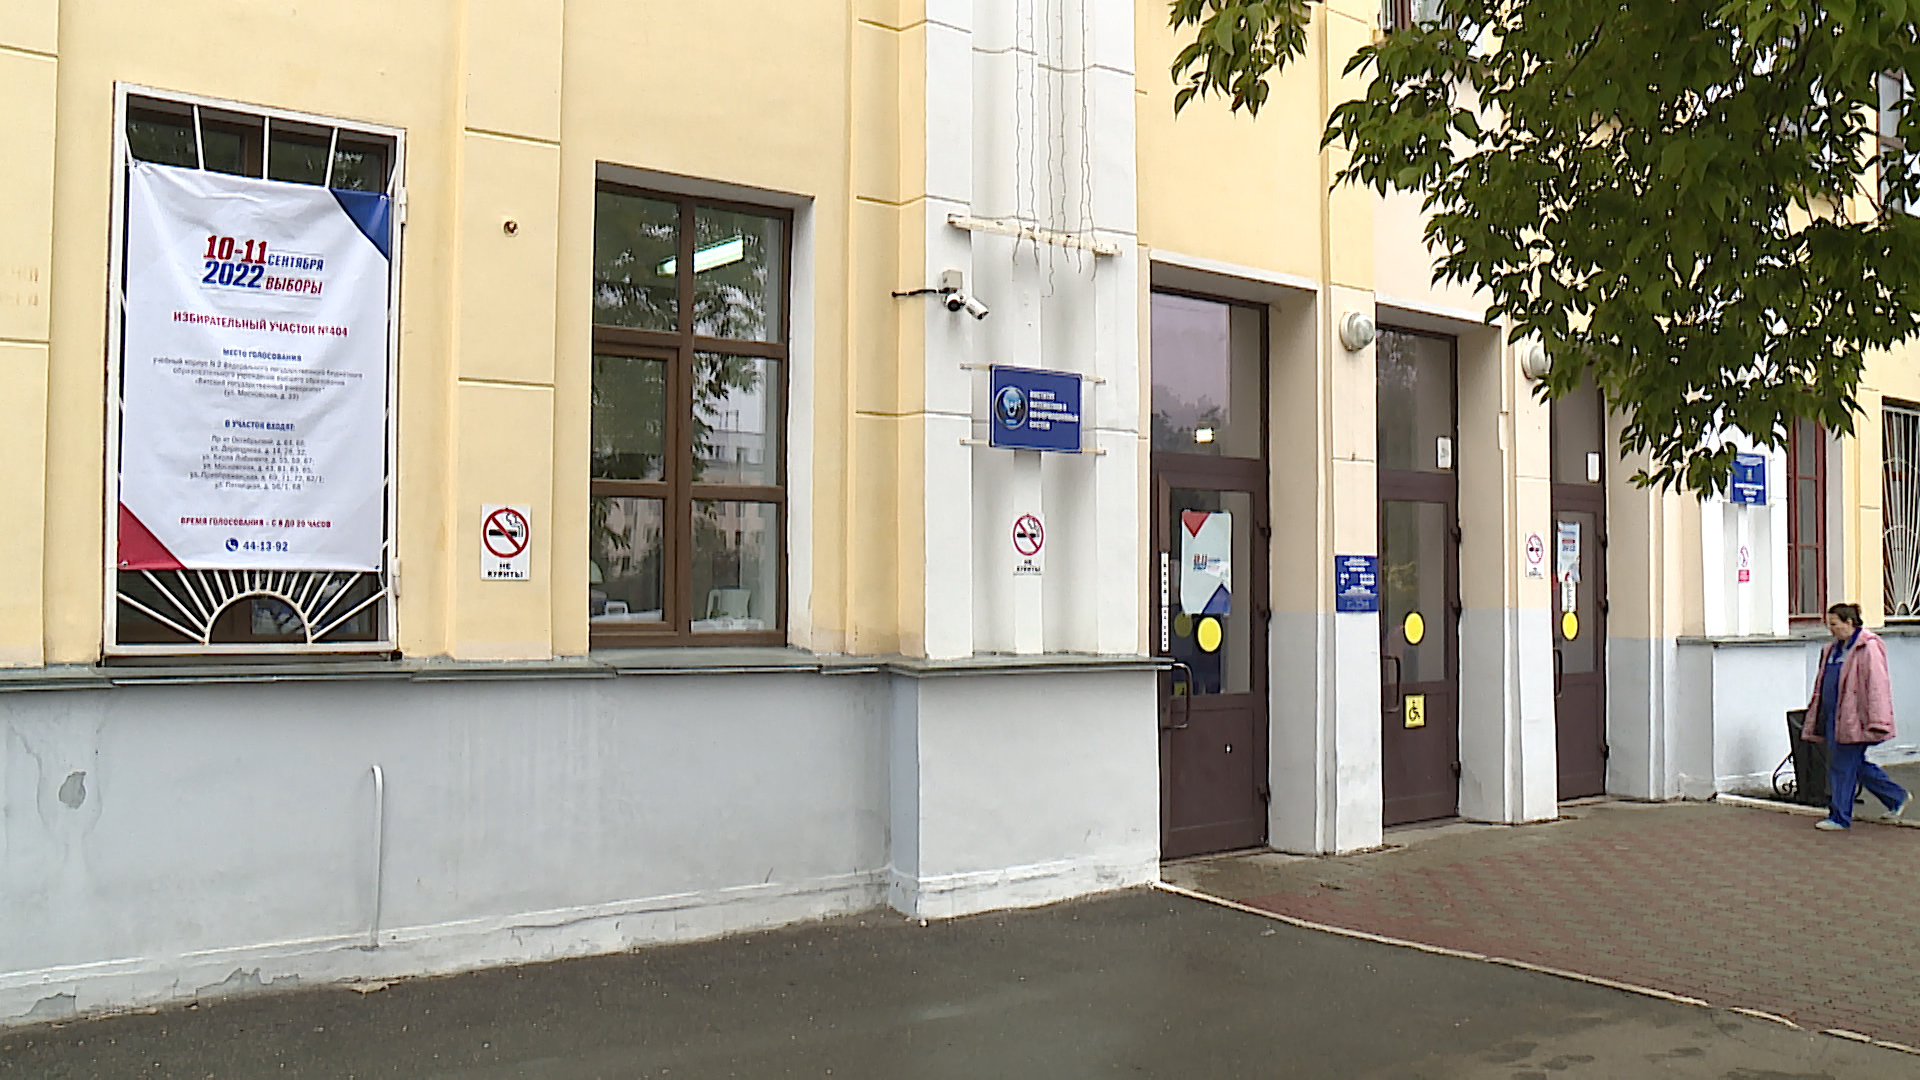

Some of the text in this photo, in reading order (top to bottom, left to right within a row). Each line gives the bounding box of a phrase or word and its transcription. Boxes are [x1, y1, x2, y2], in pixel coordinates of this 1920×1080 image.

[203, 234, 324, 272] 10-11 СЕНТЯБРЯ
[202, 260, 323, 295] 2022 ВЫБОРЫ
[173, 311, 267, 331] ИЗБИРАТЕЛЬНЫЙ
[269, 320, 316, 335] УЧАСТОК
[222, 348, 302, 361] МЕСТО ГОЛОСОВАНИЯ
[180, 516, 207, 526] ВРЕМЯ
[208, 517, 264, 527] ГОЛОСОВАНИЯ
[306, 519, 331, 528] ЧАСОВ
[242, 541, 289, 552] 44-13-92
